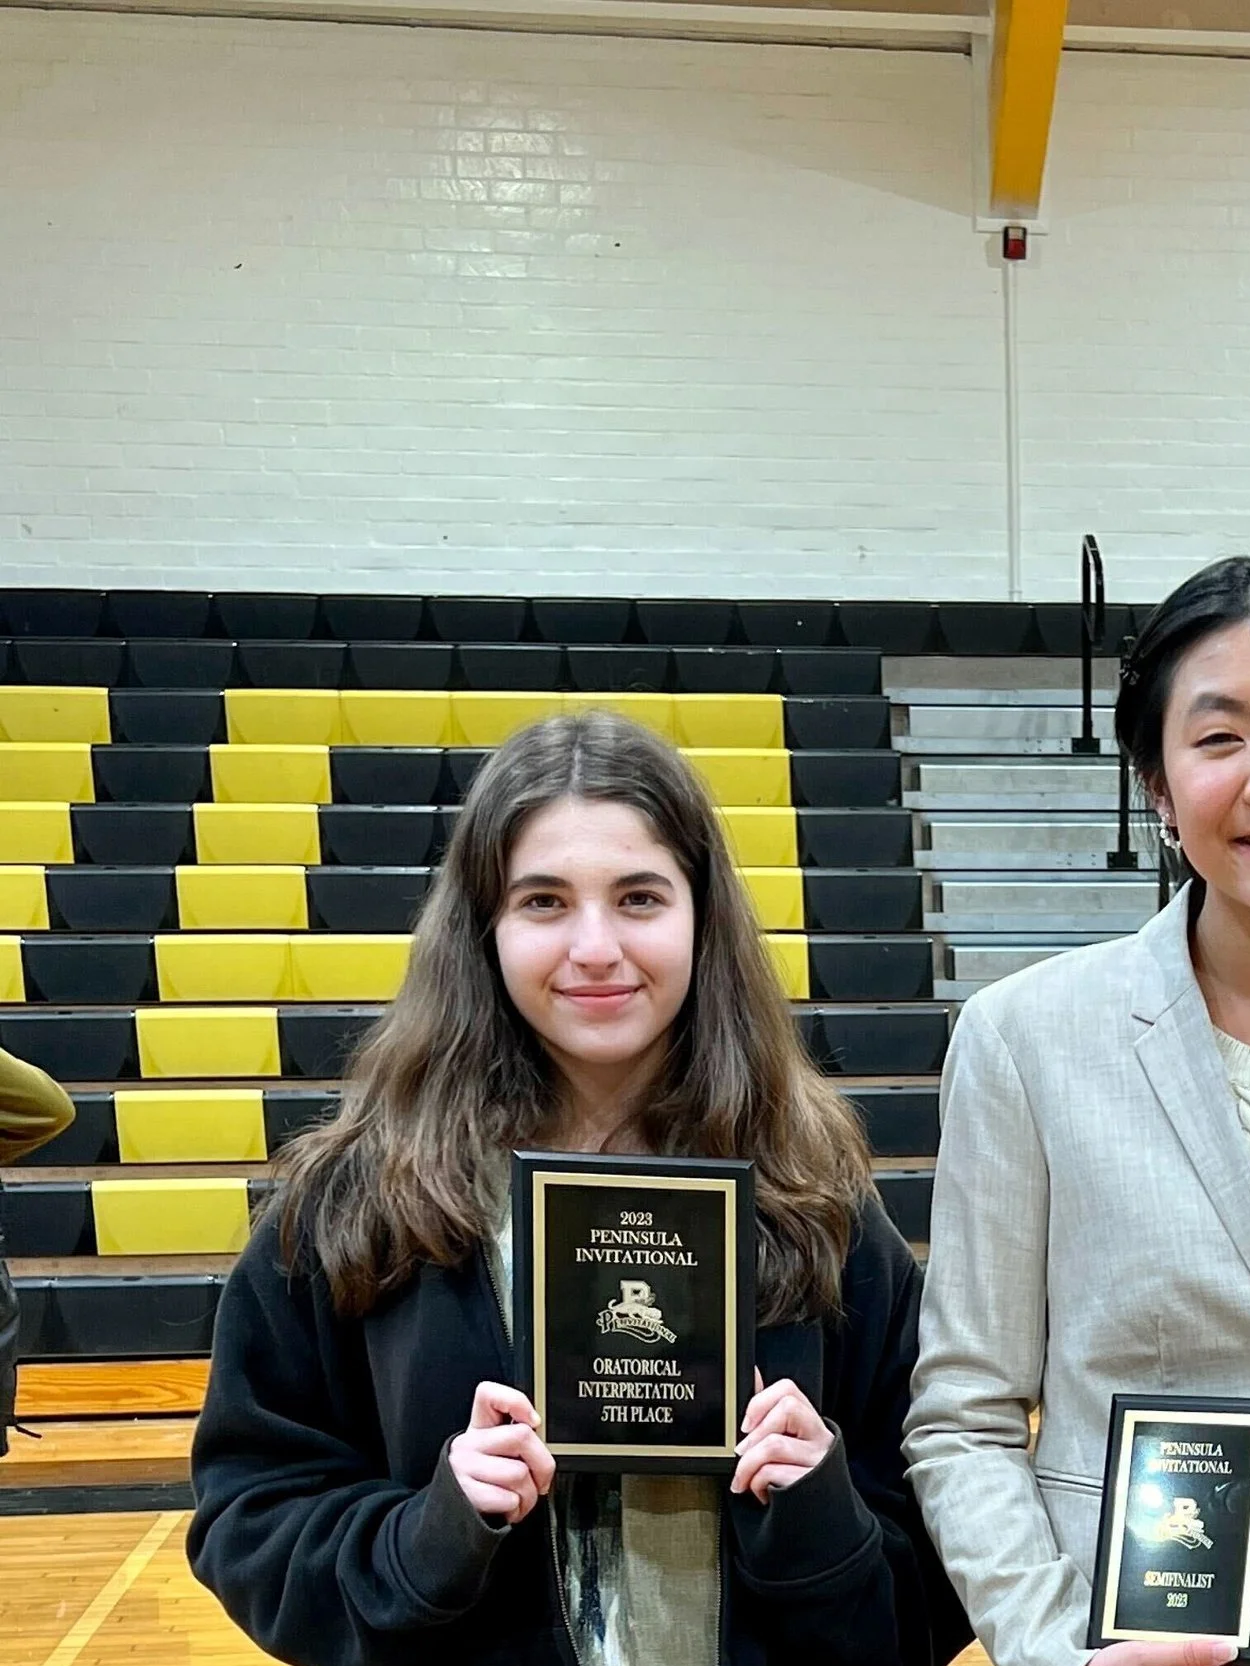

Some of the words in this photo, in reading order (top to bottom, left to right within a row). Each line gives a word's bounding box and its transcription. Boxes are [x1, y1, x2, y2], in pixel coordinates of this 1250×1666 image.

[620, 1211, 653, 1225] 2023
[591, 1229, 682, 1246] PENINSULA
[575, 1248, 698, 1266] INVITATIONAL
[593, 1358, 681, 1376] ORATORICAL
[579, 1380, 694, 1399] INTERPRETATION
[601, 1406, 628, 1422] 5TH
[631, 1406, 673, 1422] PLACE
[1160, 1442, 1223, 1456] PENINSULA
[1144, 1571, 1215, 1588] SEMIFINALIST
[1167, 1593, 1187, 1607] 2023
